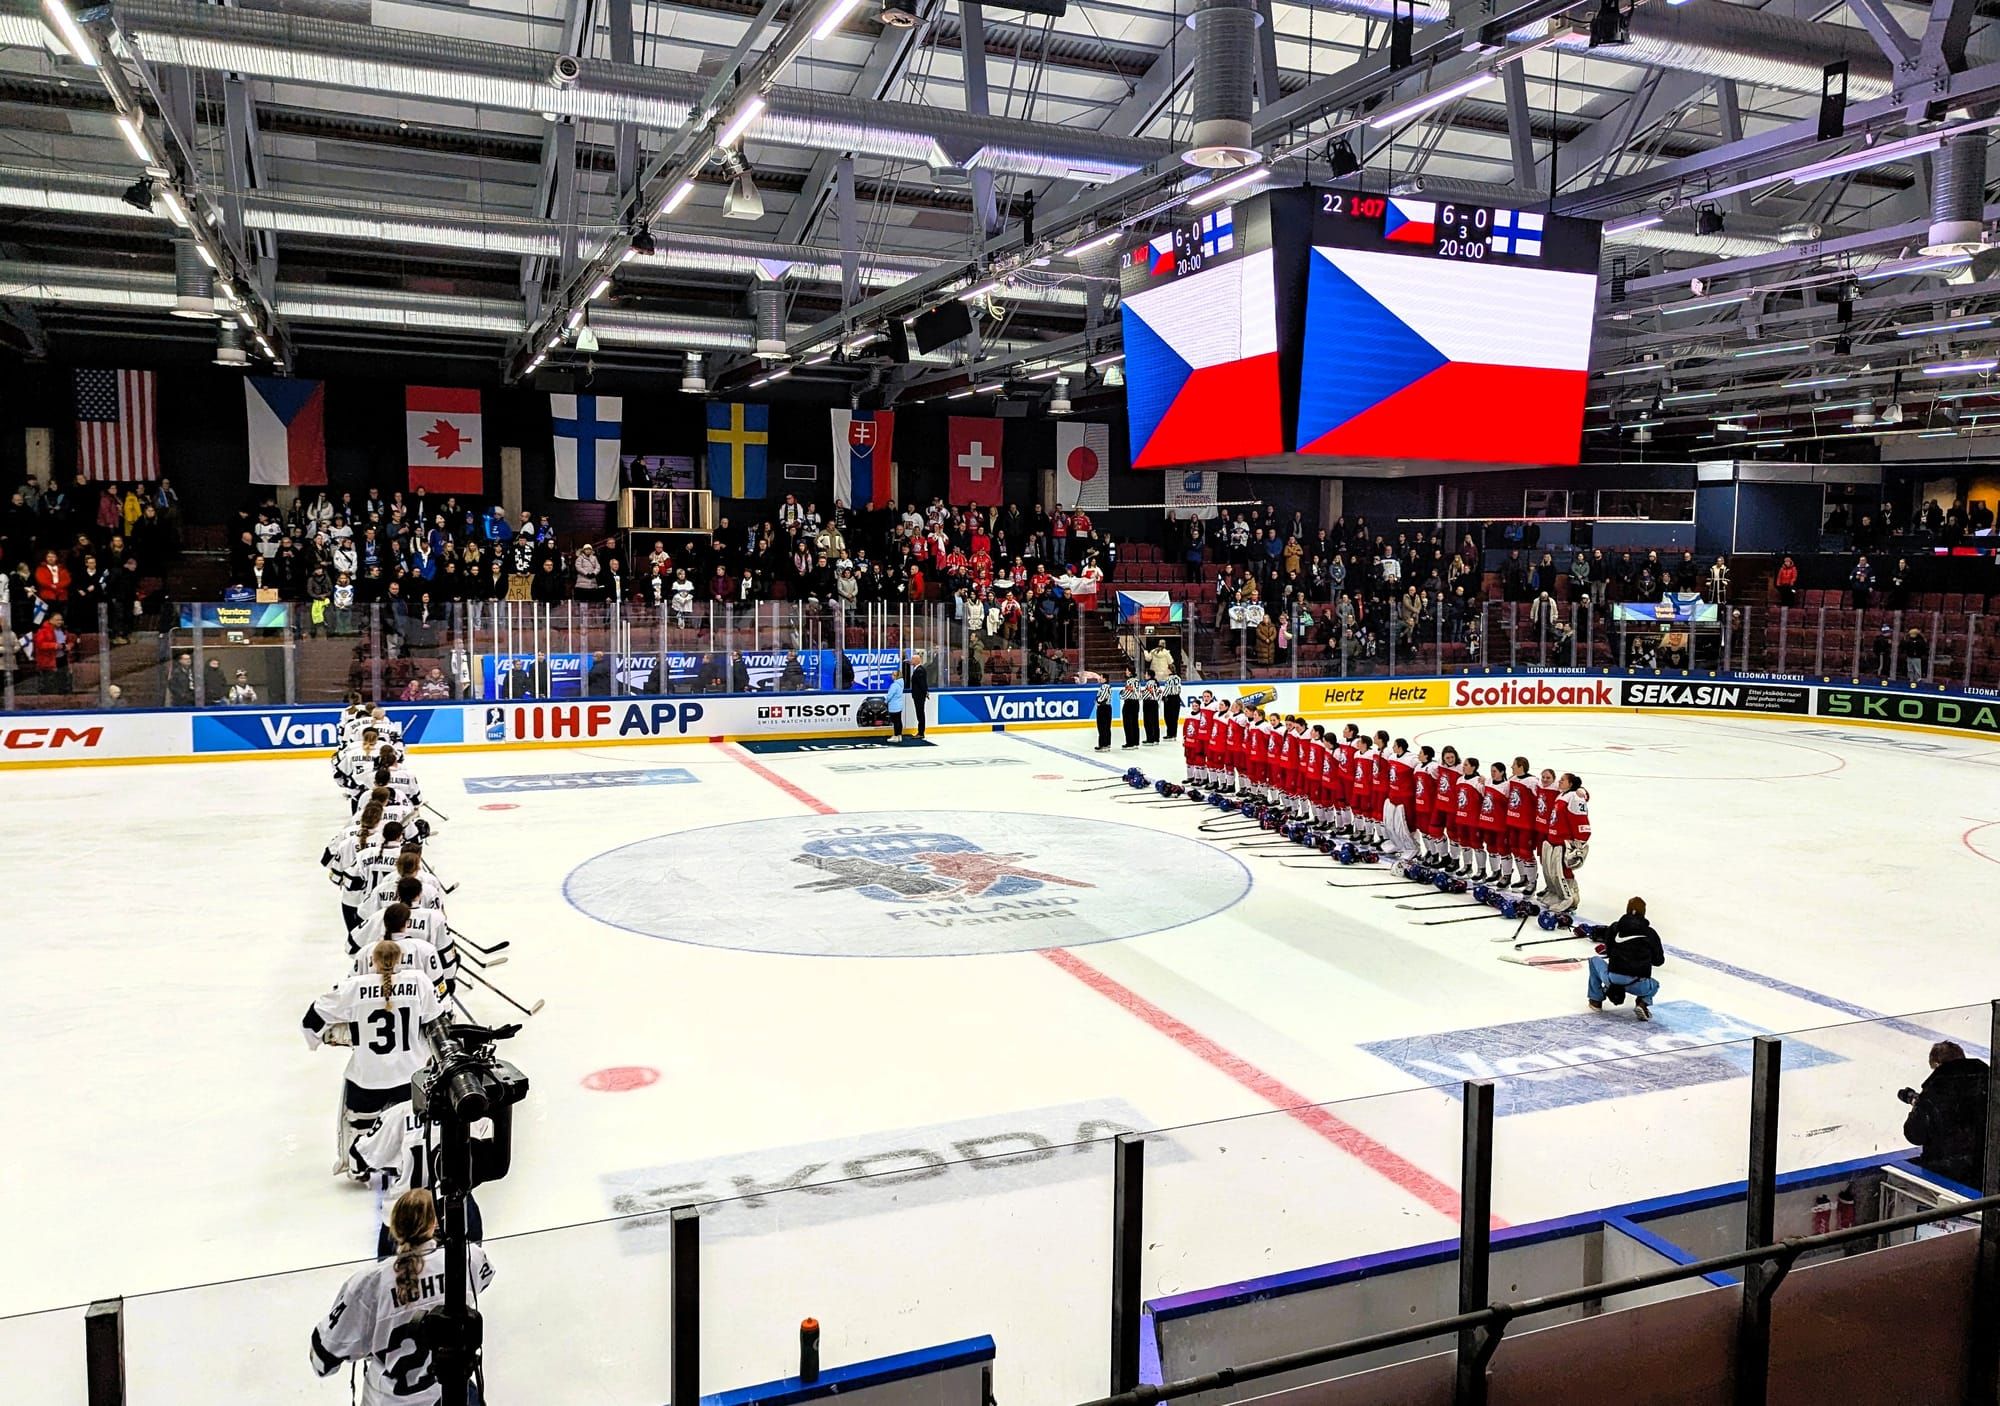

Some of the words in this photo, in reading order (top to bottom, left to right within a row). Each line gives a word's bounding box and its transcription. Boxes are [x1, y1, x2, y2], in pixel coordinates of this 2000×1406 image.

[1322, 194, 1343, 213] 22
[1350, 197, 1386, 218] 1:07
[1442, 205, 1455, 225] 6
[1474, 208, 1487, 229] 0
[1175, 228, 1183, 247] 6
[1192, 222, 1200, 241] 0
[1458, 226, 1468, 239] 3
[1185, 242, 1191, 256] 3
[1438, 238, 1485, 259] 20:00
[1121, 252, 1132, 269] 22
[1176, 254, 1202, 276] 20:00
[217, 607, 252, 616] Vantaa
[219, 616, 250, 625] Vanda
[1771, 674, 1804, 682] RUOKKII
[1325, 688, 1364, 703] Hertz
[1389, 686, 1427, 701] Hertz
[1456, 679, 1613, 706] Scotiabank
[1628, 684, 1740, 706] SEKASIN
[1963, 686, 1999, 696] LEIJONAT
[785, 704, 850, 718] TISSOT
[984, 695, 1079, 720] Vantaa
[515, 705, 612, 740] IIHF
[619, 702, 704, 737] APP
[0, 726, 104, 750] CM
[471, 772, 689, 789] Vantaa
[803, 824, 922, 838] 2025
[886, 896, 1079, 920] FINLAND
[925, 908, 1077, 928] Vantaa
[367, 1006, 411, 1055] 31
